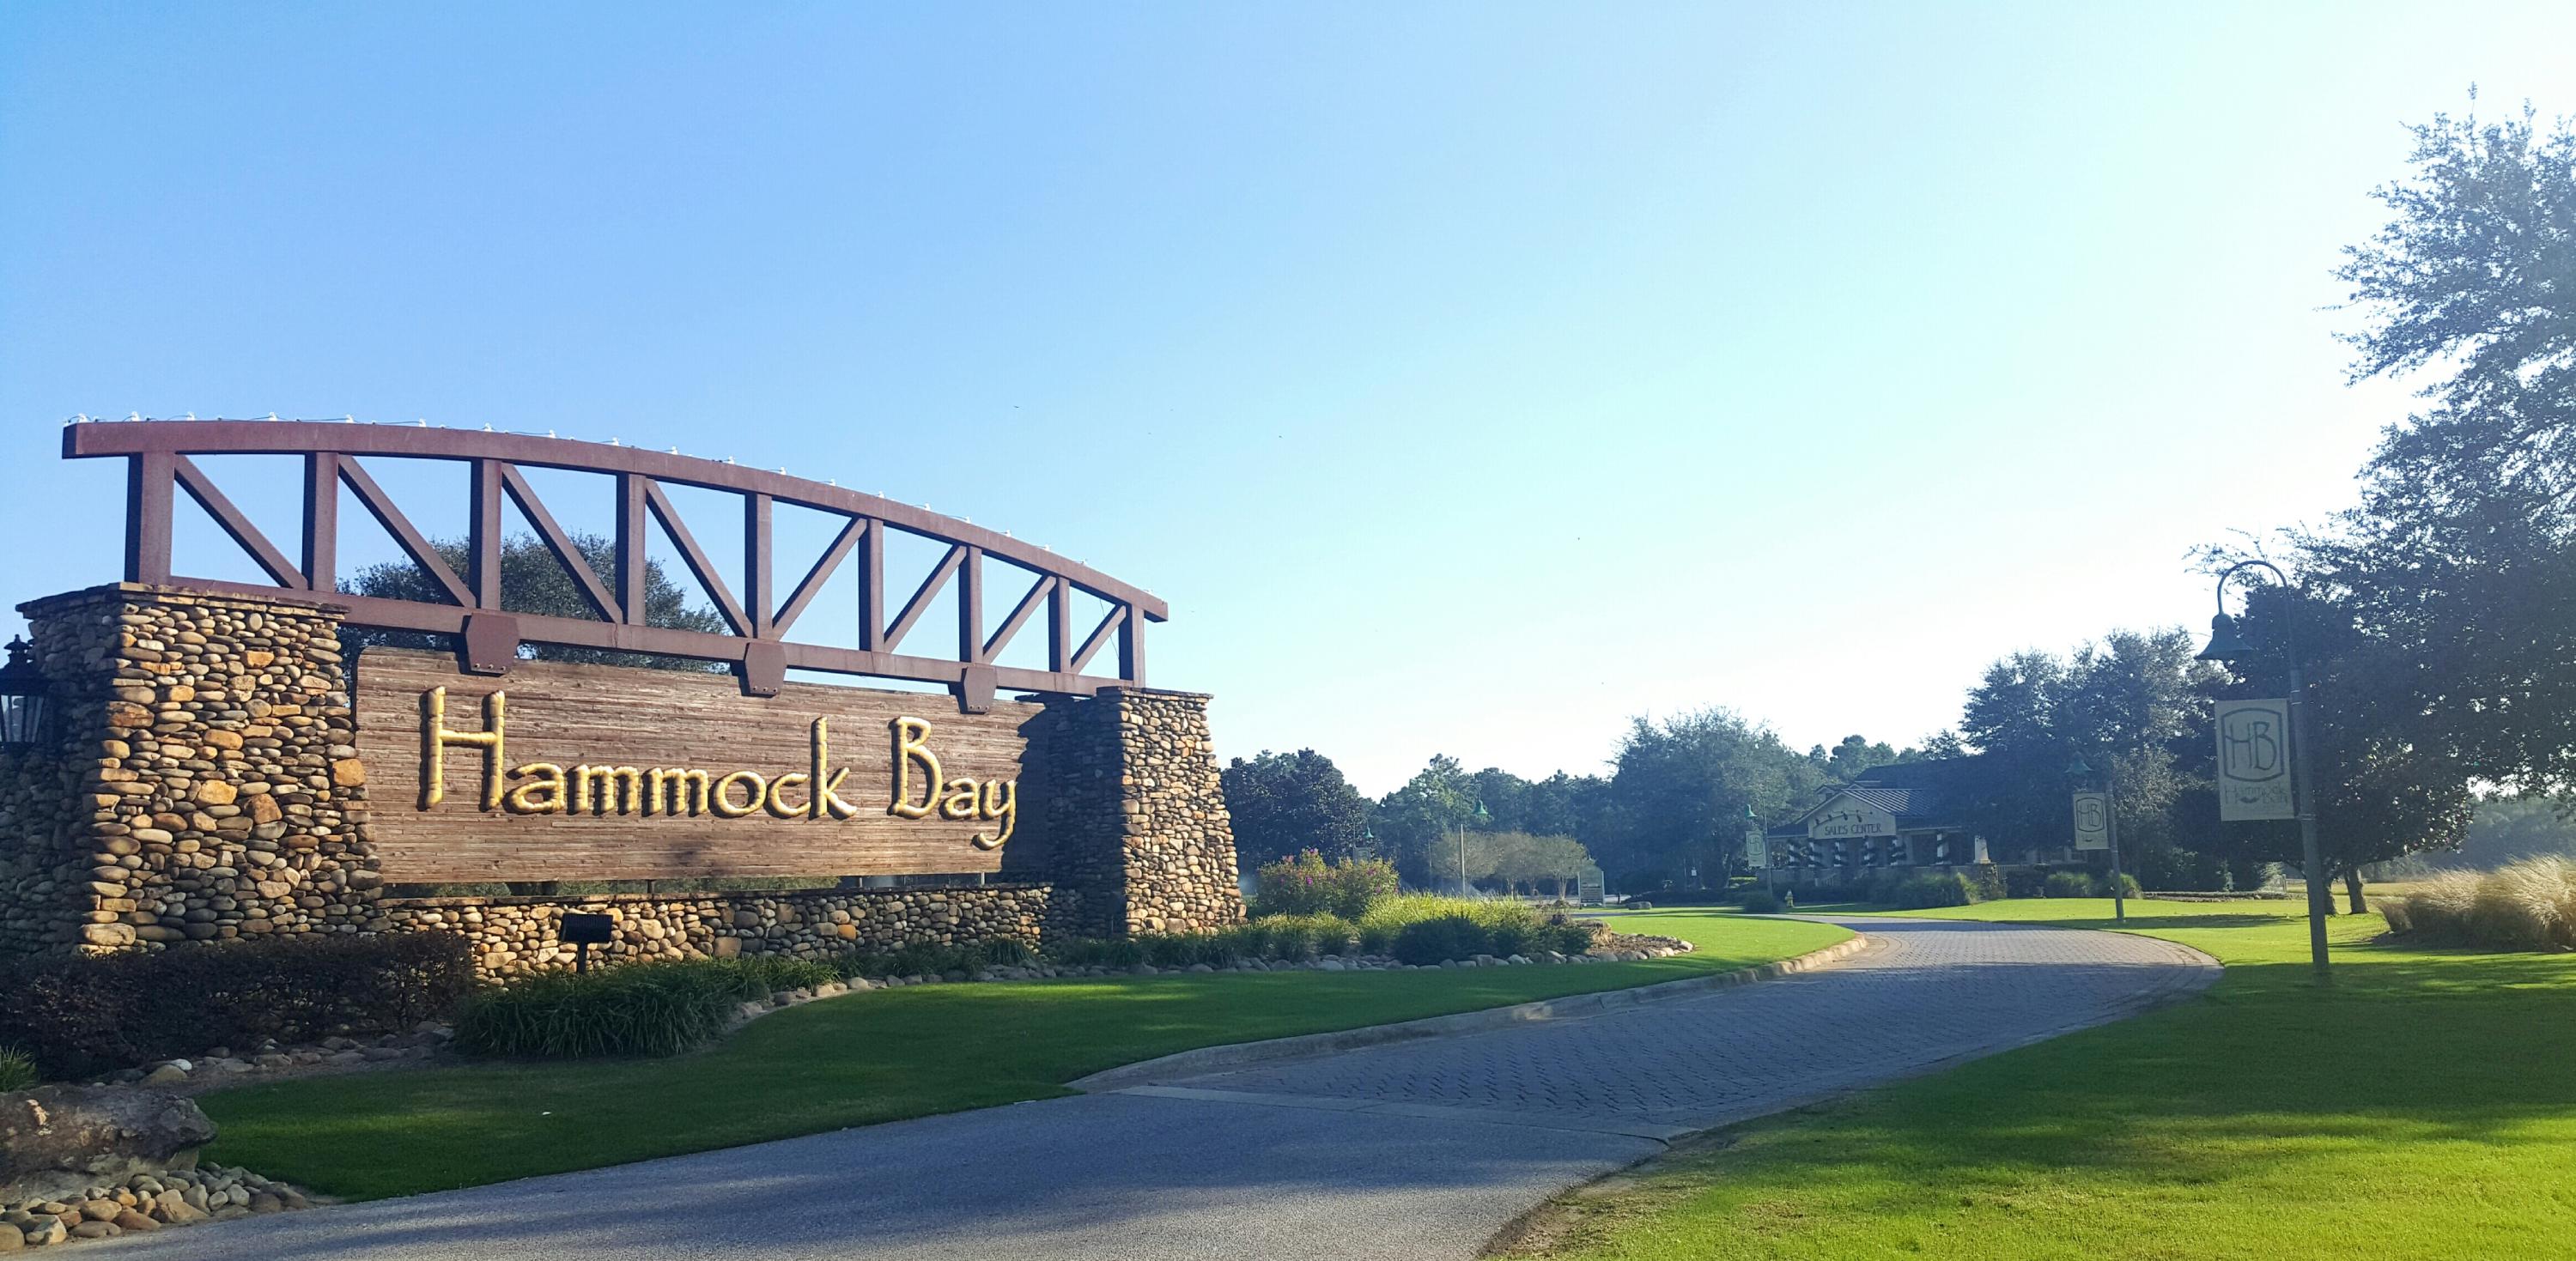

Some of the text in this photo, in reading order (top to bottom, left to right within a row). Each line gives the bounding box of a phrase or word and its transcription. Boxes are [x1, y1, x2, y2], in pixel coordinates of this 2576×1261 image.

[2226, 721, 2276, 770] HB
[422, 686, 1015, 849] Hammock Bay
[1825, 822, 1881, 835] SALES CENTER
[2077, 803, 2102, 827] HB
